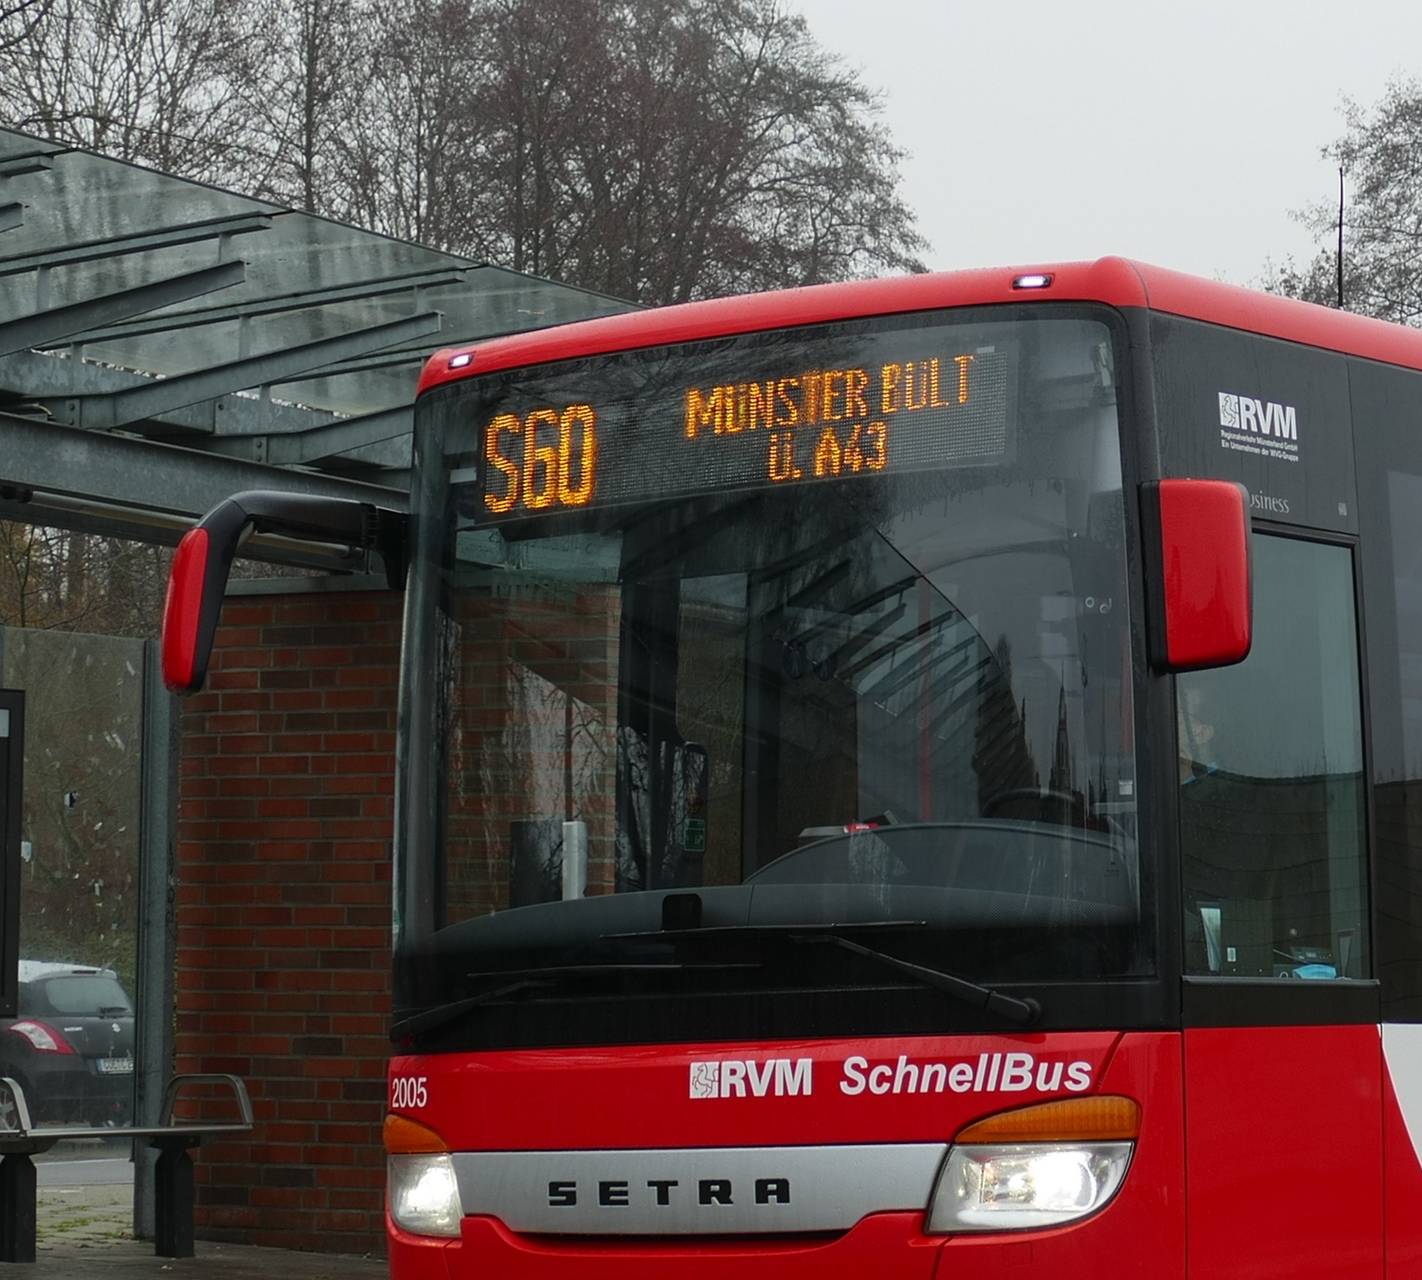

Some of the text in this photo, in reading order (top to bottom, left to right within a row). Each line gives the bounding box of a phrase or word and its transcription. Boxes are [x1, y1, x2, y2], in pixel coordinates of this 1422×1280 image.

[684, 354, 976, 438] MÜNSTER BÜLT
[1239, 396, 1297, 440] RVM
[484, 404, 597, 512] S60
[814, 421, 887, 477] A43
[391, 1076, 427, 1108] 2005
[720, 1052, 1092, 1098] RVM SchnellBus
[548, 1178, 790, 1206] SETRA
